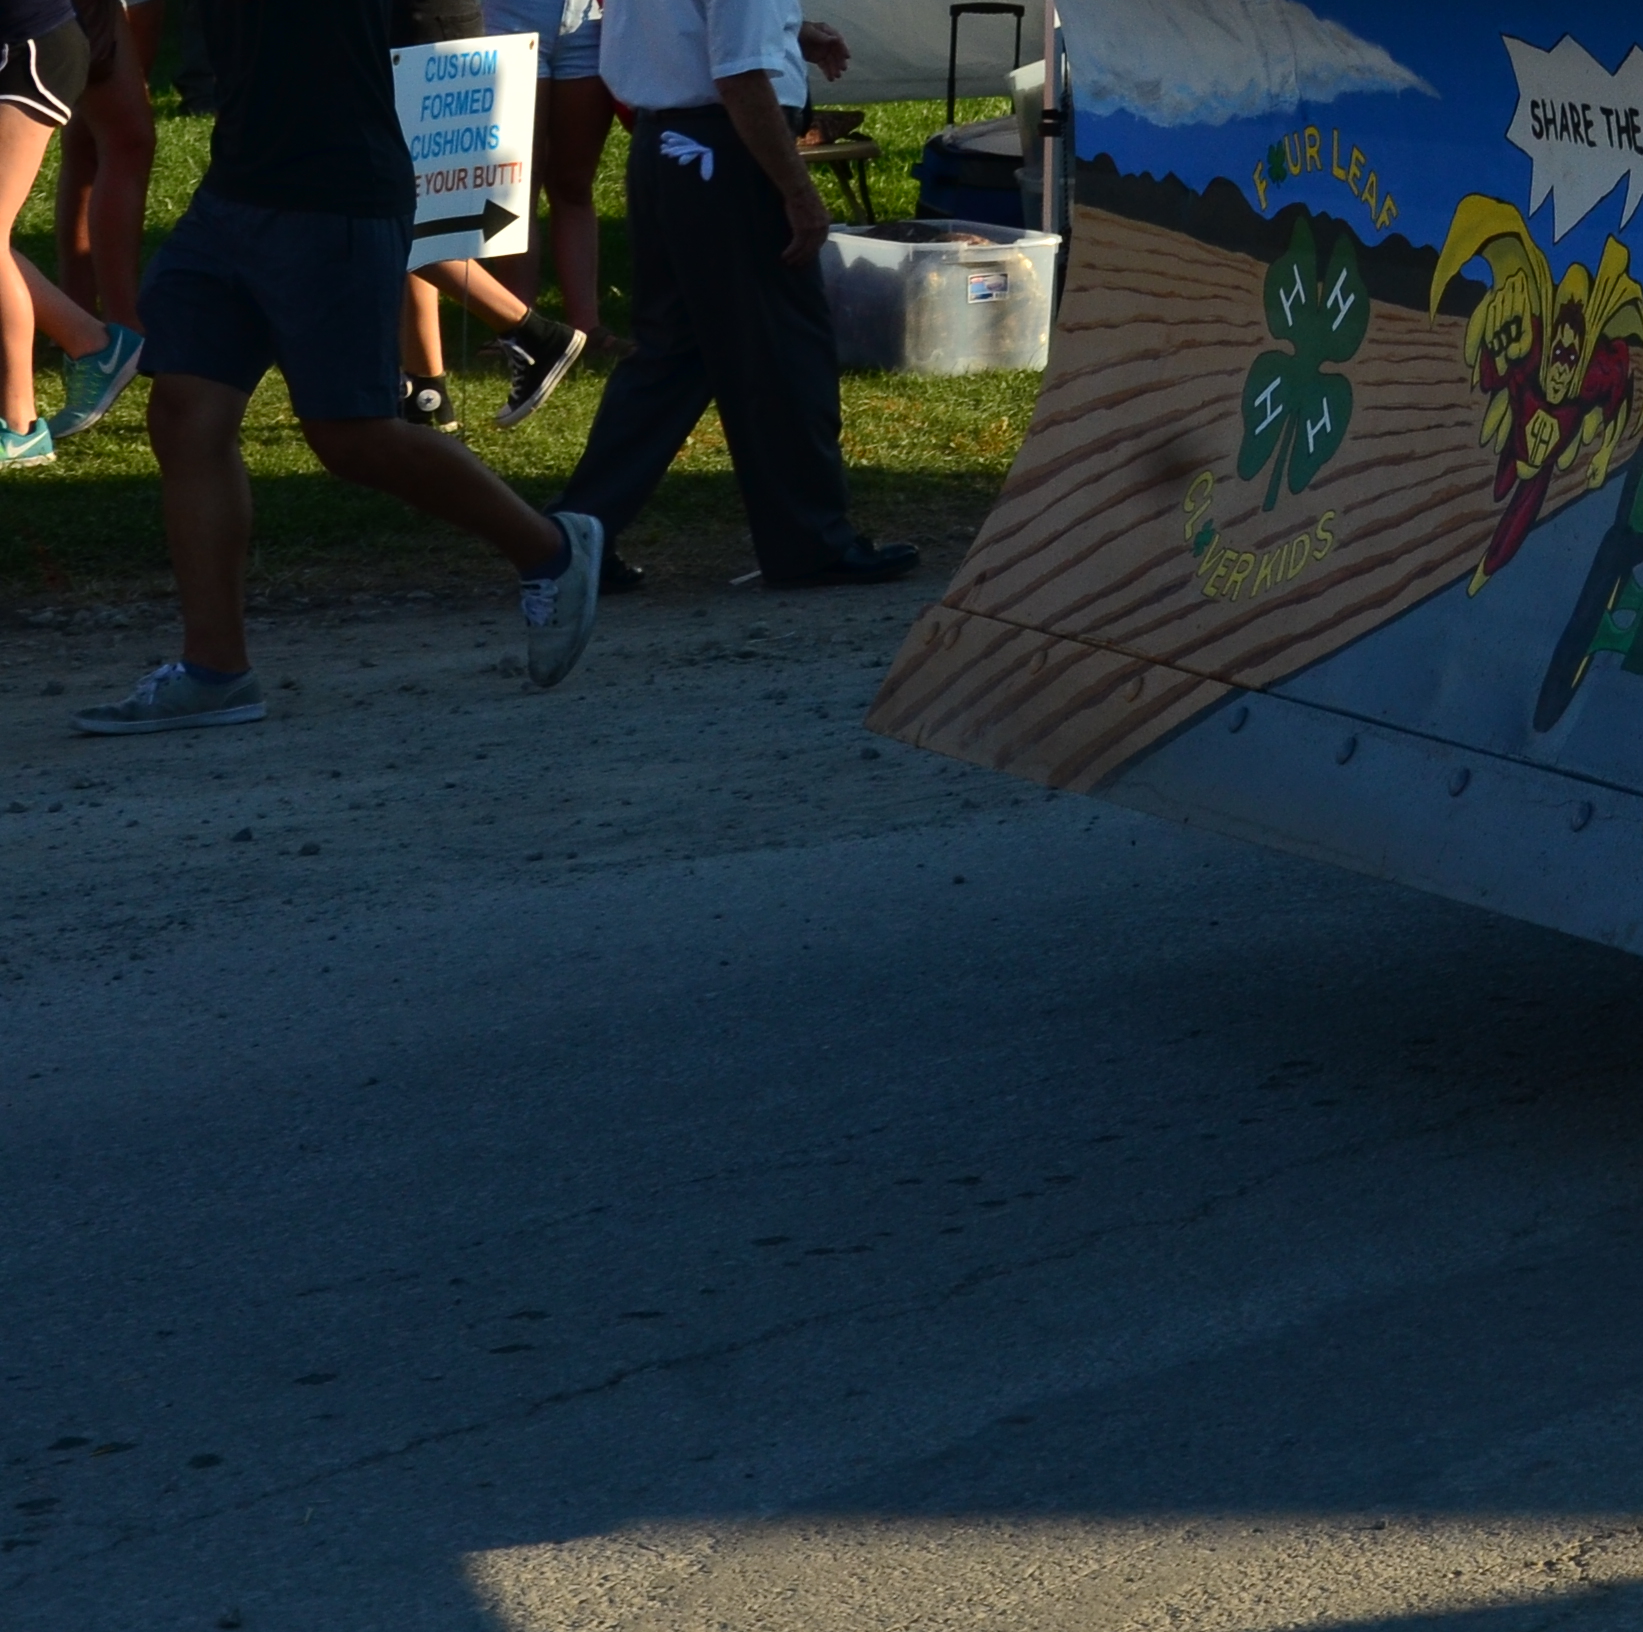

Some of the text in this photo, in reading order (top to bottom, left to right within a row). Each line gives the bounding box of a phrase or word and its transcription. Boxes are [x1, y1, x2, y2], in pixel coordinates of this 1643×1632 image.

[425, 50, 498, 83] CUSTOM
[420, 87, 495, 122] FORMED
[1530, 98, 1598, 148] SHARE
[410, 124, 500, 162] CUSHIONS
[425, 167, 467, 196] YOUR
[472, 161, 523, 189] BUTT!
[1331, 127, 1399, 232] LEAF
[1250, 509, 1337, 599] KIDS
